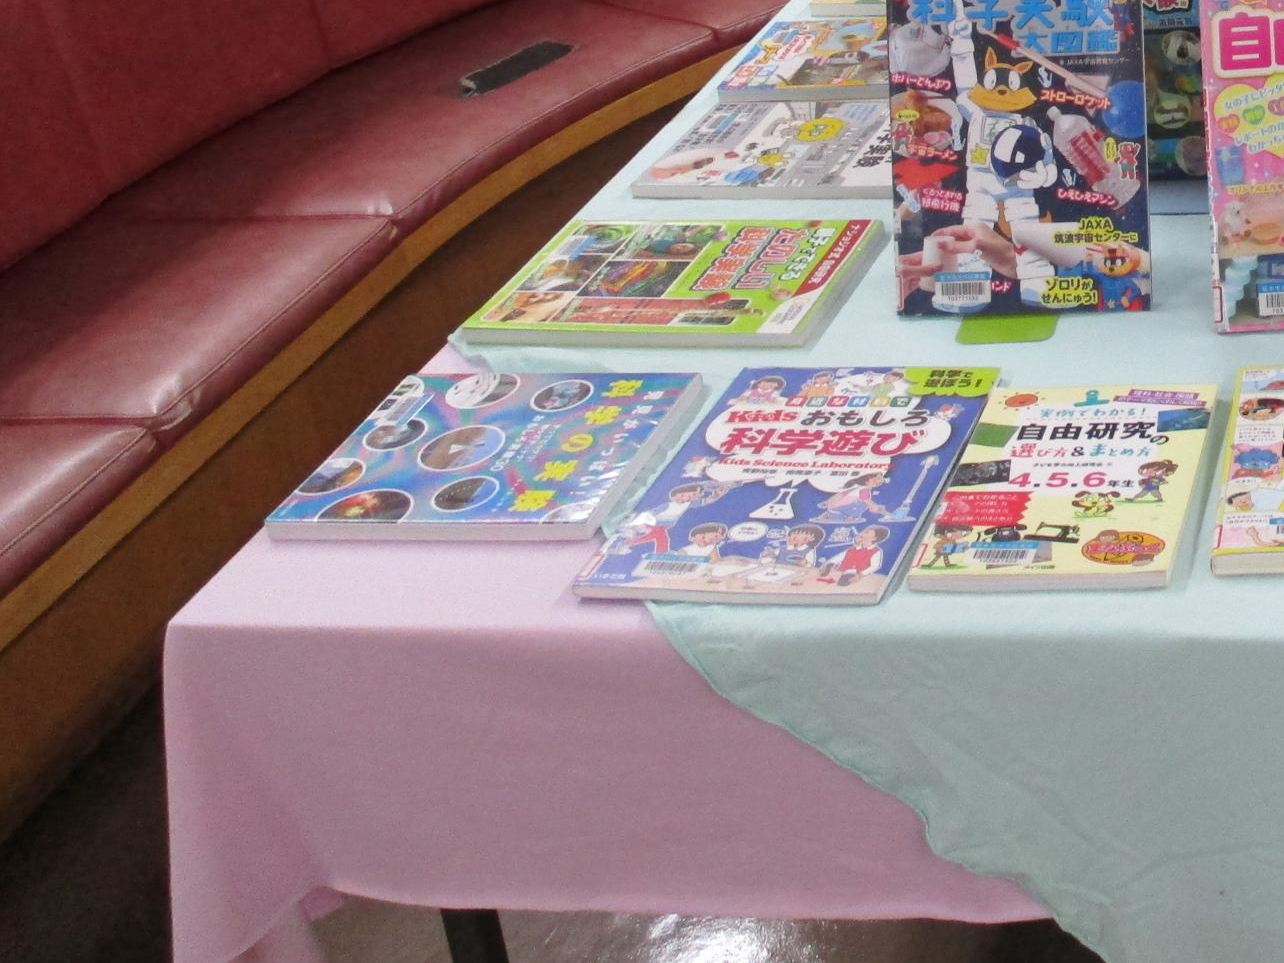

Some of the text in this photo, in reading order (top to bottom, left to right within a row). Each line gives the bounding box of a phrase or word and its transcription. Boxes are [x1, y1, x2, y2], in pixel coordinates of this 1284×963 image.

[1020, 30, 1119, 55] 大図鑑
[1040, 88, 1112, 111] ストローロケット
[1057, 188, 1116, 206] ひえひえマシン
[1079, 218, 1114, 231] JAXA
[1054, 233, 1139, 244] 筑波宇宙センターに
[1046, 279, 1094, 292] ゾロリが
[1041, 292, 1098, 305] せんにゅう!
[724, 409, 799, 424] Kids
[800, 409, 929, 427] おもしろ
[1039, 408, 1146, 418] 実例でわかる!
[508, 379, 644, 513] 科学の実験
[720, 427, 925, 456] 科学遊び
[719, 458, 893, 471] Kids Science Laboratory
